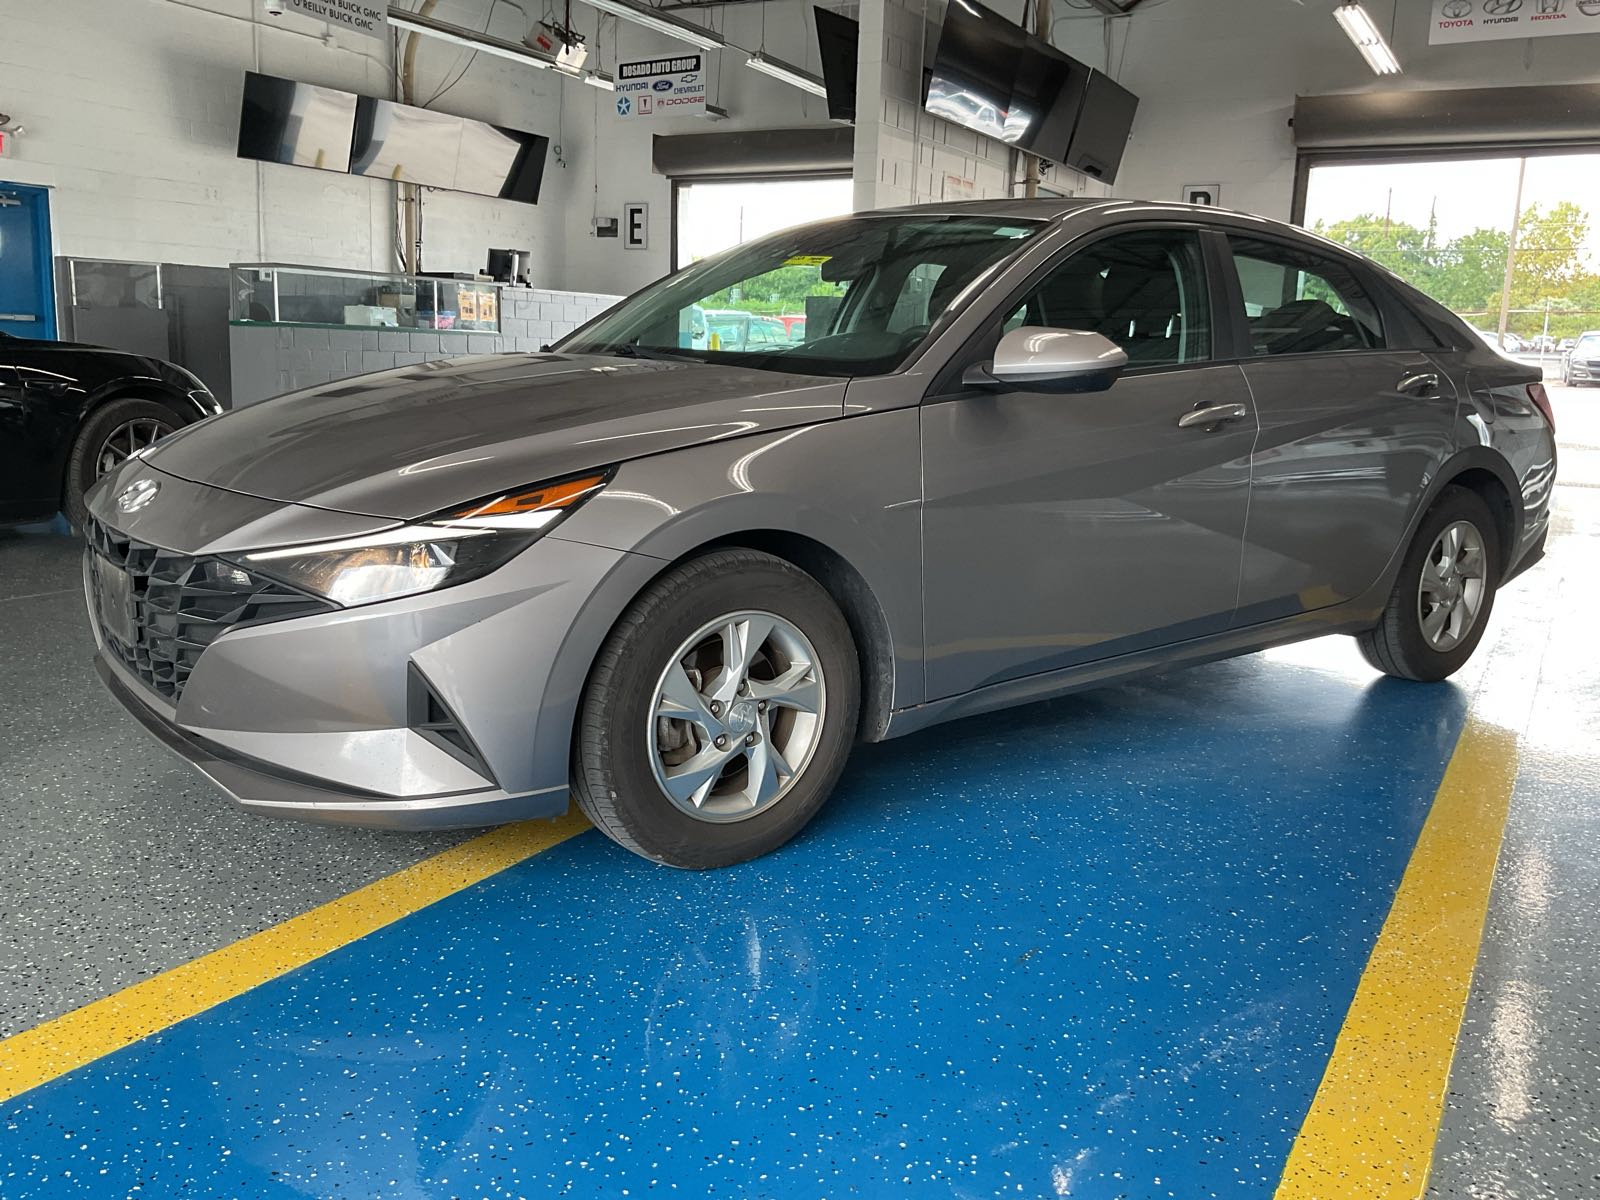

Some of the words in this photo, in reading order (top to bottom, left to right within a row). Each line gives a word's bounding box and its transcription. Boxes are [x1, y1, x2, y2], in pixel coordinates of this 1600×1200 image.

[338, 0, 361, 14] BUICK
[363, 8, 381, 21] GMC
[329, 8, 353, 24] BUICK
[355, 17, 373, 31] GMC
[1483, 16, 1519, 25] HYUNDAI
[1530, 13, 1567, 21] HONDA
[1438, 19, 1474, 29] TOYOTA
[622, 63, 651, 77] ROSADO
[651, 60, 671, 74] AUTO
[671, 58, 697, 72] GROUP
[615, 82, 649, 92] HYUNDAI
[673, 84, 705, 95] CHEVROLET
[666, 96, 705, 106] DODGE
[629, 208, 643, 245] E
